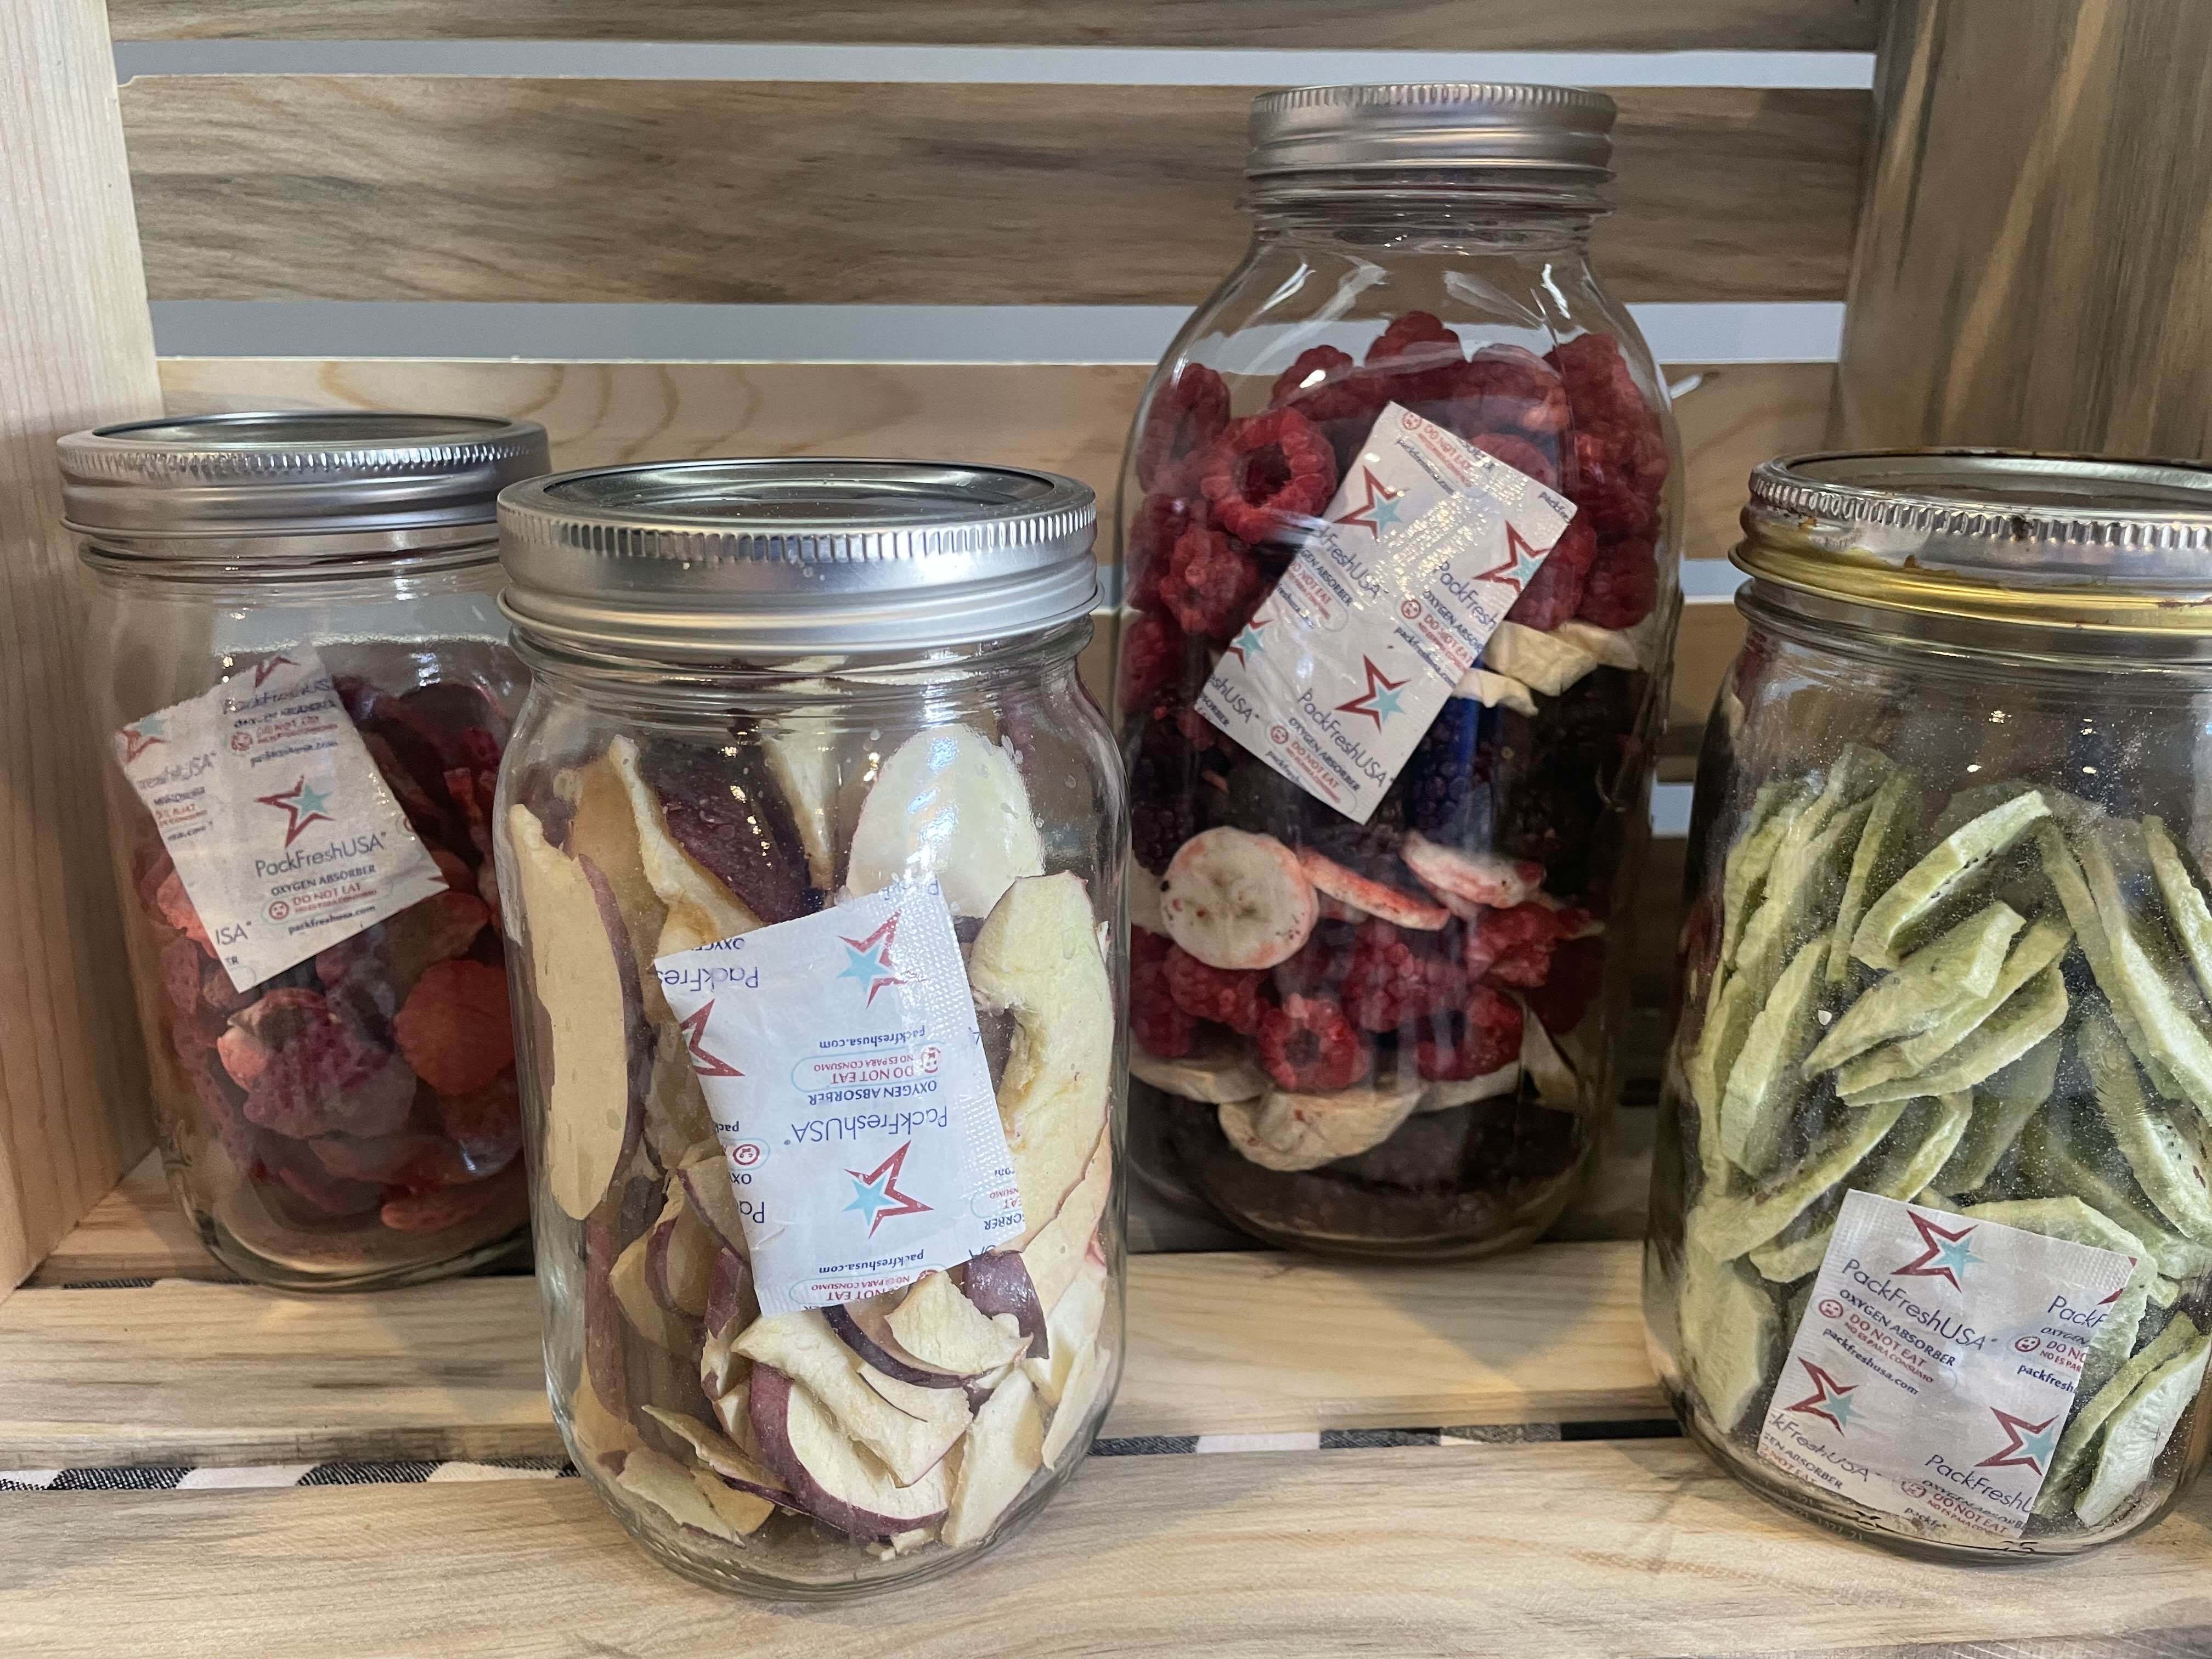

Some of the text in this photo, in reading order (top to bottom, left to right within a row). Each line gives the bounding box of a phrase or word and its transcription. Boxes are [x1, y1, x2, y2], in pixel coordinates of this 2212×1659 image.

[1312, 527, 1380, 599] kFreshUSA
[1299, 688, 1387, 787] PackFreshUSA
[1289, 717, 1322, 753] OXYGEN
[1318, 752, 1361, 791] ABSORBER
[256, 833, 384, 878] PackFreshUSA
[271, 865, 376, 896] OXYGEN ABSORBER
[292, 894, 311, 906] DO
[314, 887, 339, 900] NOT
[658, 966, 758, 991] PackFre
[820, 1025, 925, 1048] packfreshusa.com
[814, 1053, 913, 1071] NO ES PARA CONSUMO
[830, 1065, 915, 1085] DO NOT EAT
[808, 1080, 938, 1105] OXYGEN ABSORBER
[791, 1105, 947, 1143] PackFreshUSA
[737, 1201, 764, 1223] Pa
[819, 1249, 924, 1273] packfreshusa.com
[812, 1282, 860, 1290] CONSUMO
[862, 1277, 883, 1286] PARA
[827, 1291, 851, 1301] EAT
[1842, 1259, 1986, 1351] PackFreshUSA
[2047, 1295, 2108, 1328] PackF
[1839, 1289, 1955, 1366] OXYGEN ABSORBER
[1844, 1322, 1858, 1334] NO
[1866, 1340, 1889, 1358] PARA
[1849, 1314, 1927, 1367] DO NOT EAT
[2040, 1327, 2090, 1345] OXYGEN
[2040, 1350, 2054, 1361] NO
[2055, 1356, 2065, 1365] ES
[2046, 1341, 2067, 1353] DO
[1822, 1328, 1918, 1395] packfreshusa.com
[2017, 1364, 2075, 1393] packfresh
[1954, 1504, 1984, 1522] NOT
[1983, 1519, 2009, 1533] EAT
